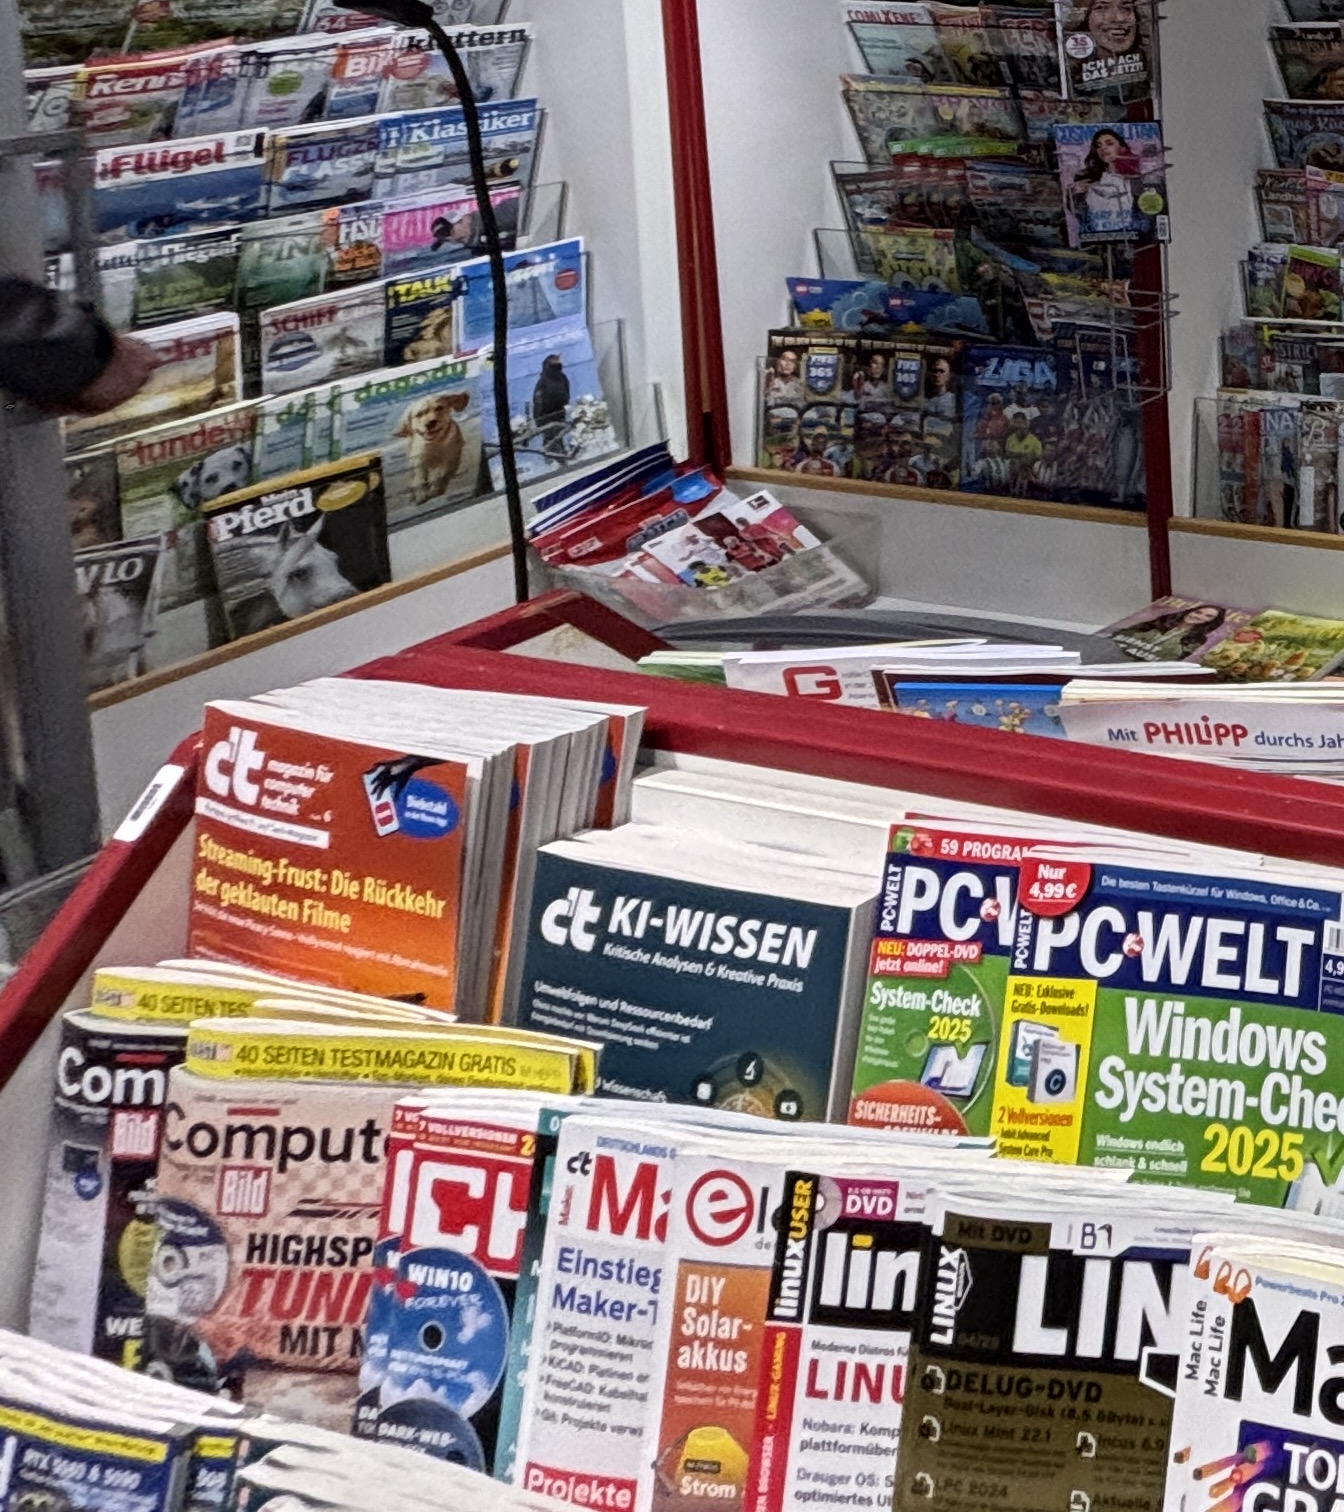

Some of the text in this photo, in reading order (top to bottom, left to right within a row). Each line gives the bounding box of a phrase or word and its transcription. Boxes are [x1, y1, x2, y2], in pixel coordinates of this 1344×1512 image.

[216, 487, 316, 541] Pferd
[1107, 726, 1138, 746] Mit
[1143, 716, 1248, 748] PHILIPP
[1254, 730, 1312, 751] durchs
[198, 832, 446, 920] Streaming-Frust: Die Rückkehr
[1038, 863, 1066, 880] Nur
[196, 870, 351, 934] der geklauten Filme
[608, 896, 817, 969] KI-WISSEN
[603, 943, 650, 963] Kritische
[652, 952, 704, 974] Analysen
[718, 962, 766, 984] Kreative
[768, 971, 804, 992] Praxis
[927, 1016, 972, 1040] 2025
[1124, 996, 1327, 1074] Windows
[236, 1043, 517, 1076] 40 SEITEN TESTMAGAZIN GRATIS
[1200, 1123, 1303, 1181] 2025
[845, 1193, 894, 1216] DVD
[408, 1264, 475, 1292] WIN10
[685, 1274, 726, 1304] DIY
[681, 1307, 752, 1340] Solar-
[678, 1344, 748, 1373] akkus
[527, 1463, 632, 1508] Projekte
[679, 1476, 736, 1500] Strom
